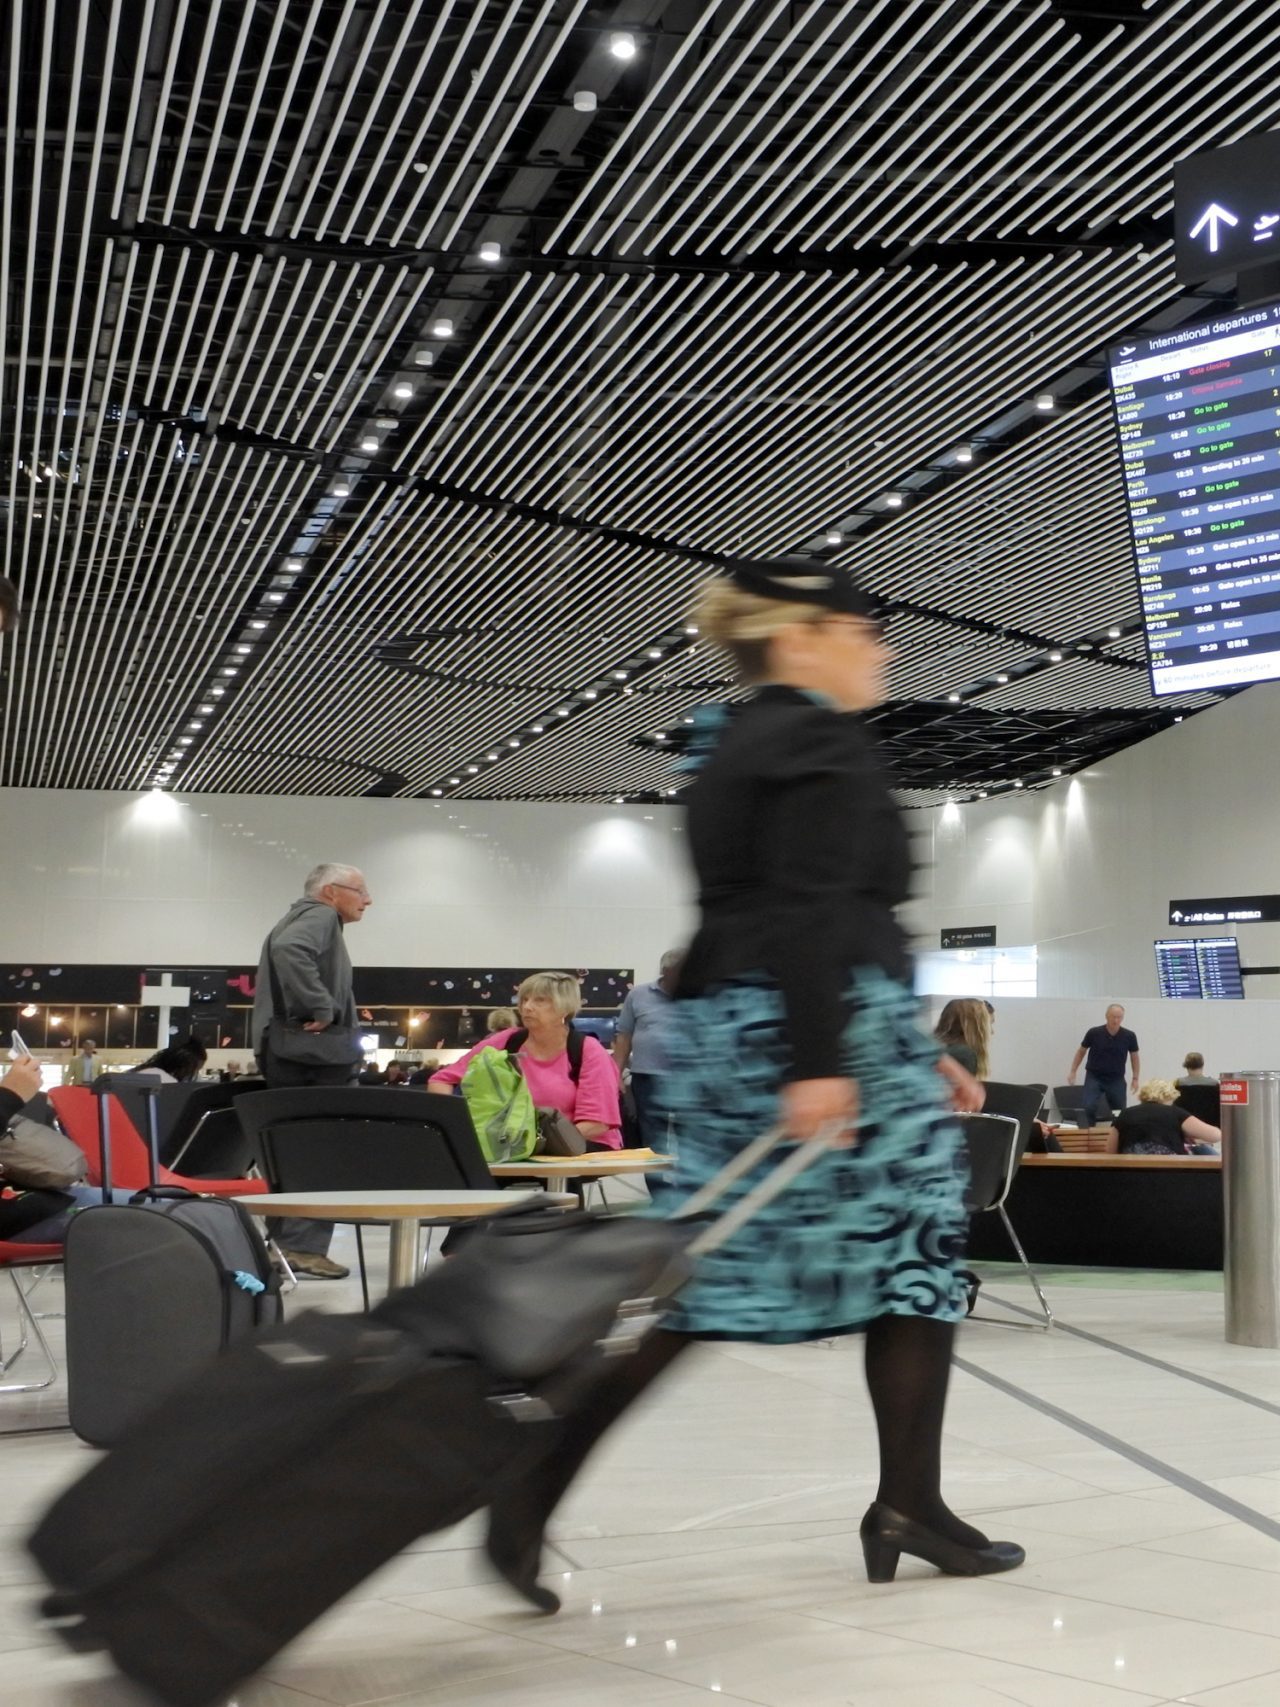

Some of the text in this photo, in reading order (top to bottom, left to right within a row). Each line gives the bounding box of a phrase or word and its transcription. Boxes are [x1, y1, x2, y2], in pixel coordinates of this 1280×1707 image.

[1149, 325, 1210, 350] International
[1212, 312, 1267, 333] departures
[1114, 383, 1133, 394] Dubai
[1124, 460, 1144, 471] Dubai
[1130, 498, 1156, 509] Houston
